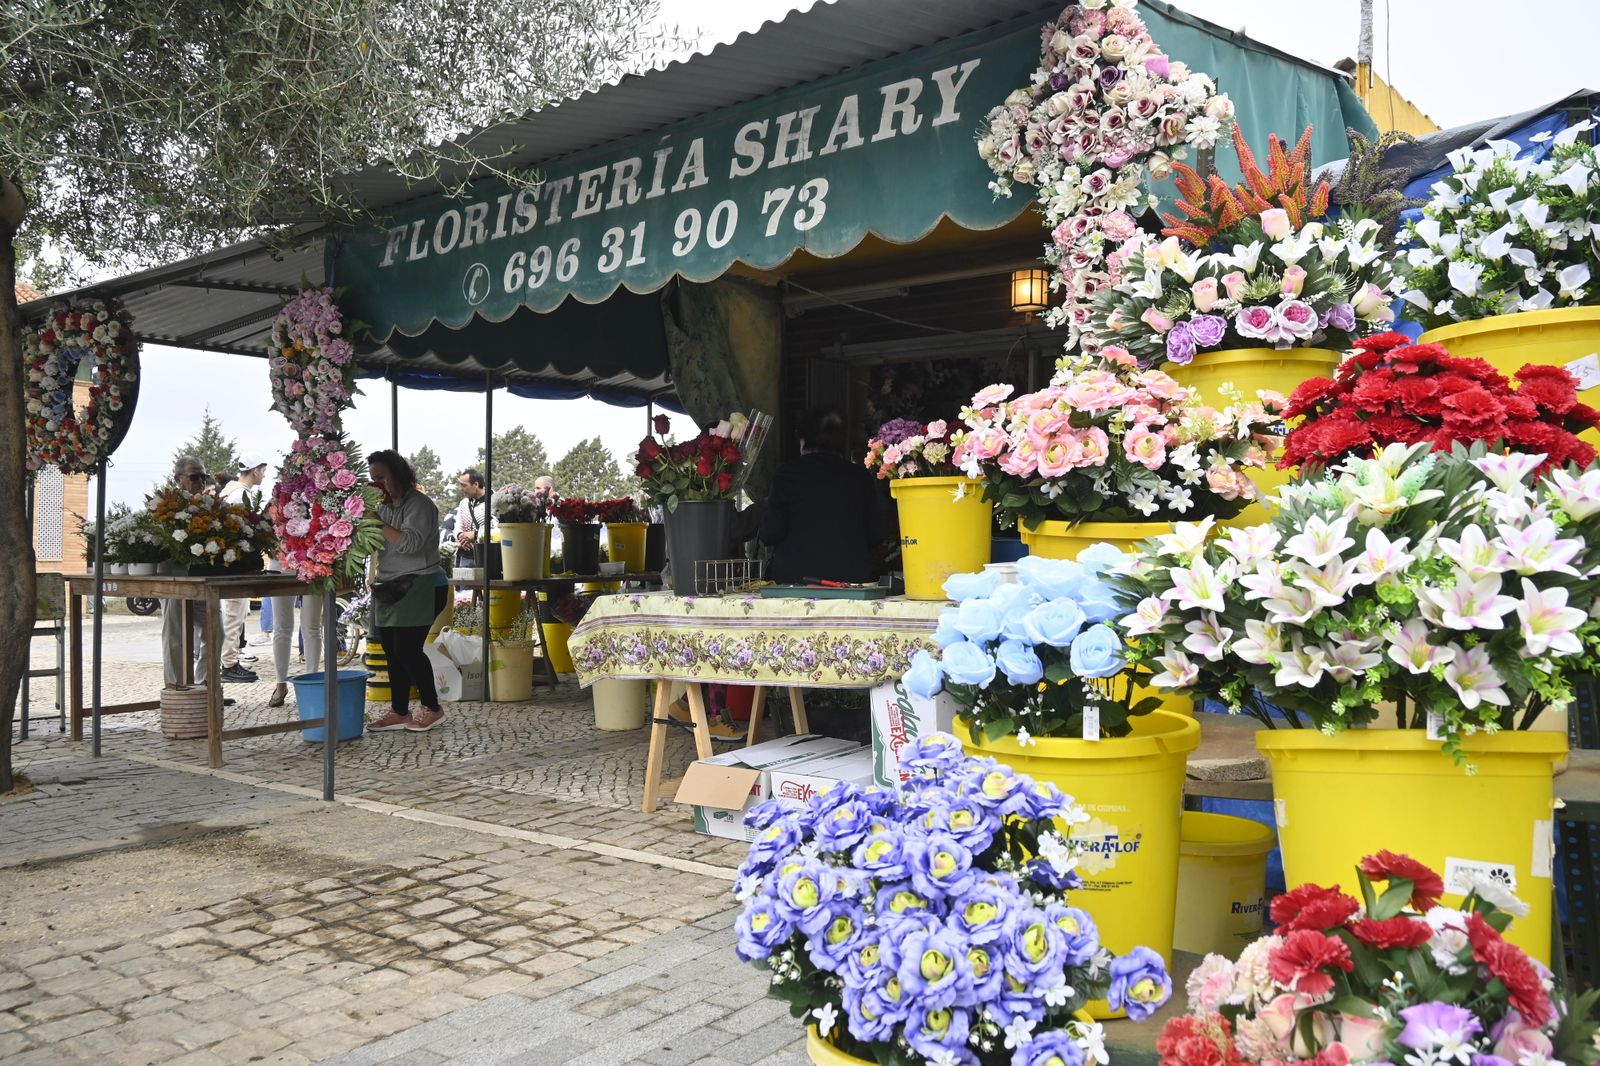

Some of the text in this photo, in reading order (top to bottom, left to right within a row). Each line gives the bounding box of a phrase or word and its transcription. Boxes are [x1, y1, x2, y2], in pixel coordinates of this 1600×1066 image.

[378, 58, 981, 268] FLORISTERÍA SHARY
[503, 178, 829, 293] 696 31 90 73
